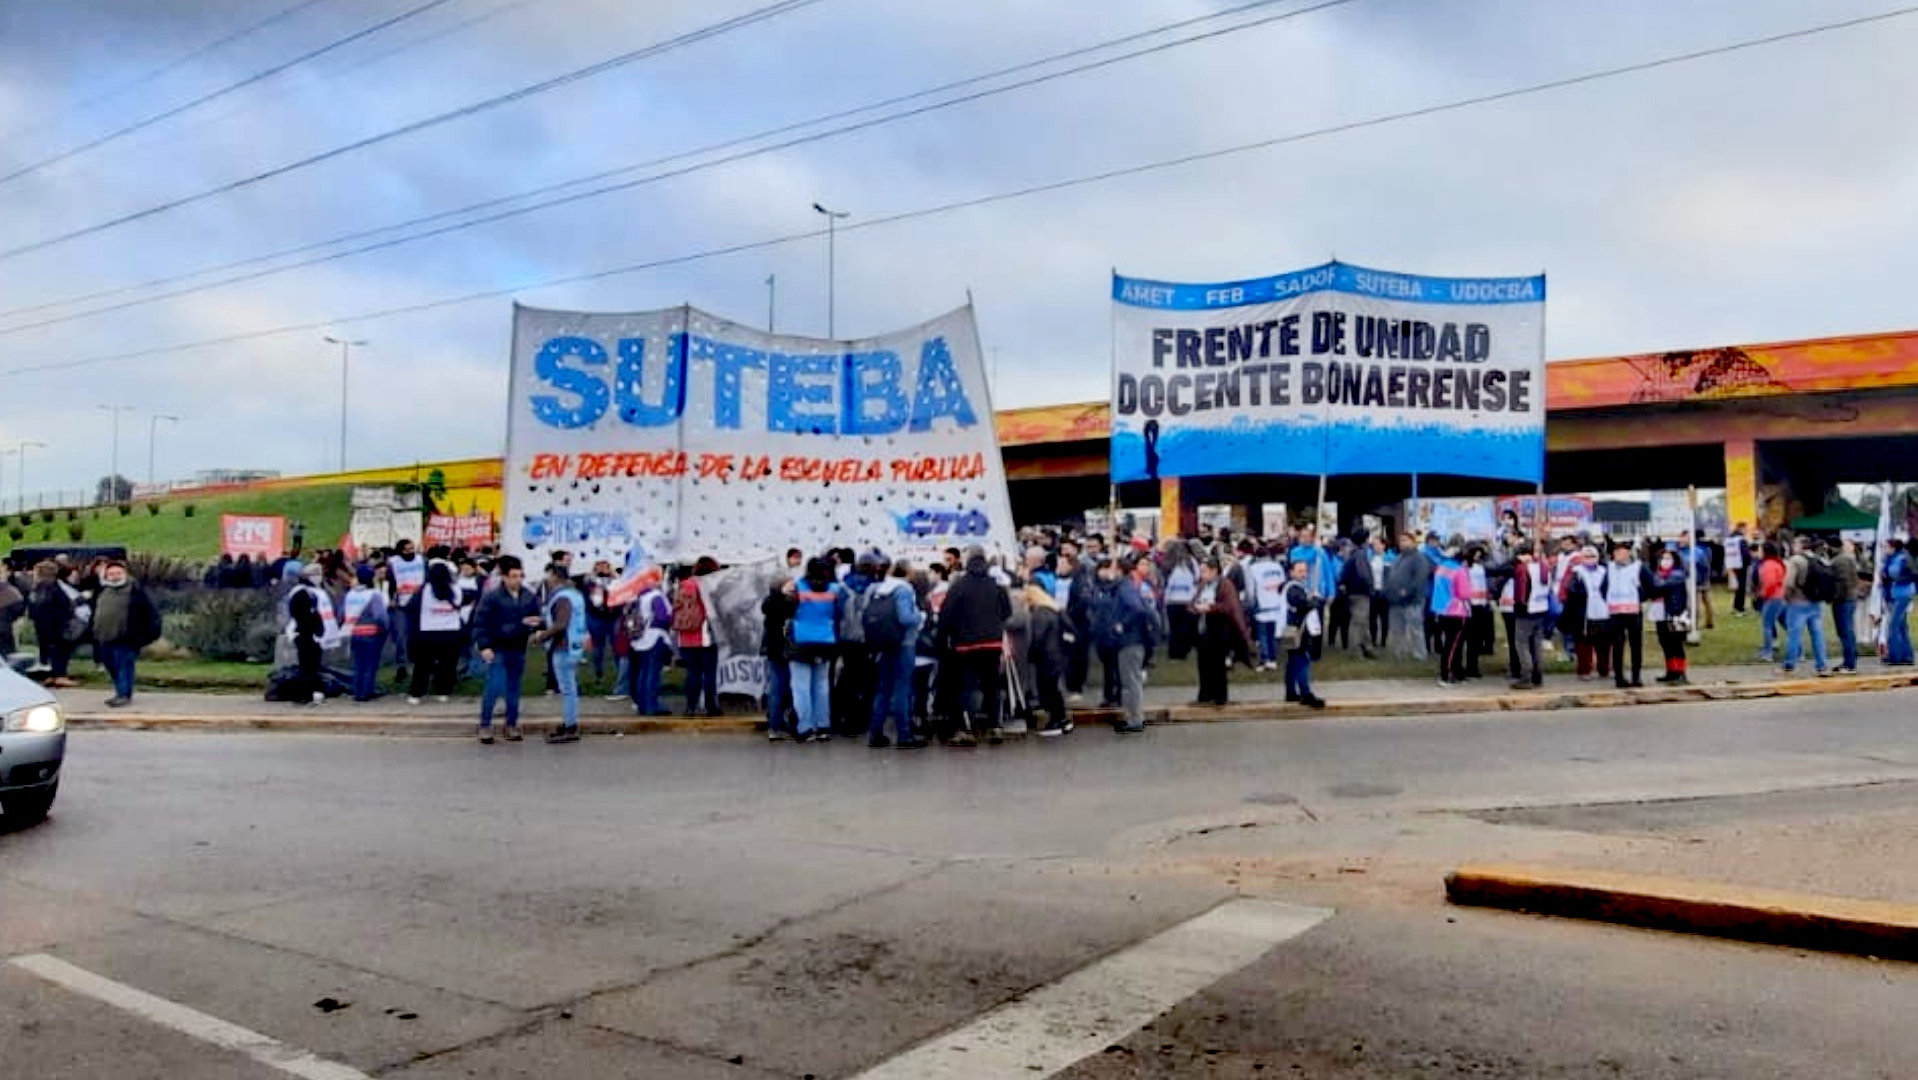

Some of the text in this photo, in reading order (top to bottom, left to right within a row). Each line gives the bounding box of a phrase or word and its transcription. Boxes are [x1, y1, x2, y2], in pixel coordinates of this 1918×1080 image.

[1121, 280, 1175, 306] AMET
[1206, 286, 1244, 305] FEB
[1355, 273, 1422, 298] SUTEBA
[1451, 280, 1535, 301] UDOCBA
[1153, 311, 1490, 369] FRENTE DE UNIDAD
[529, 331, 978, 435] SUTEBA
[1118, 360, 1531, 418] DOCENTE BONAERENSE
[529, 453, 569, 479] EN
[575, 451, 689, 478] DEFENSA
[699, 453, 734, 480] DE
[739, 455, 771, 481] LA
[779, 455, 882, 483] ESCUELA
